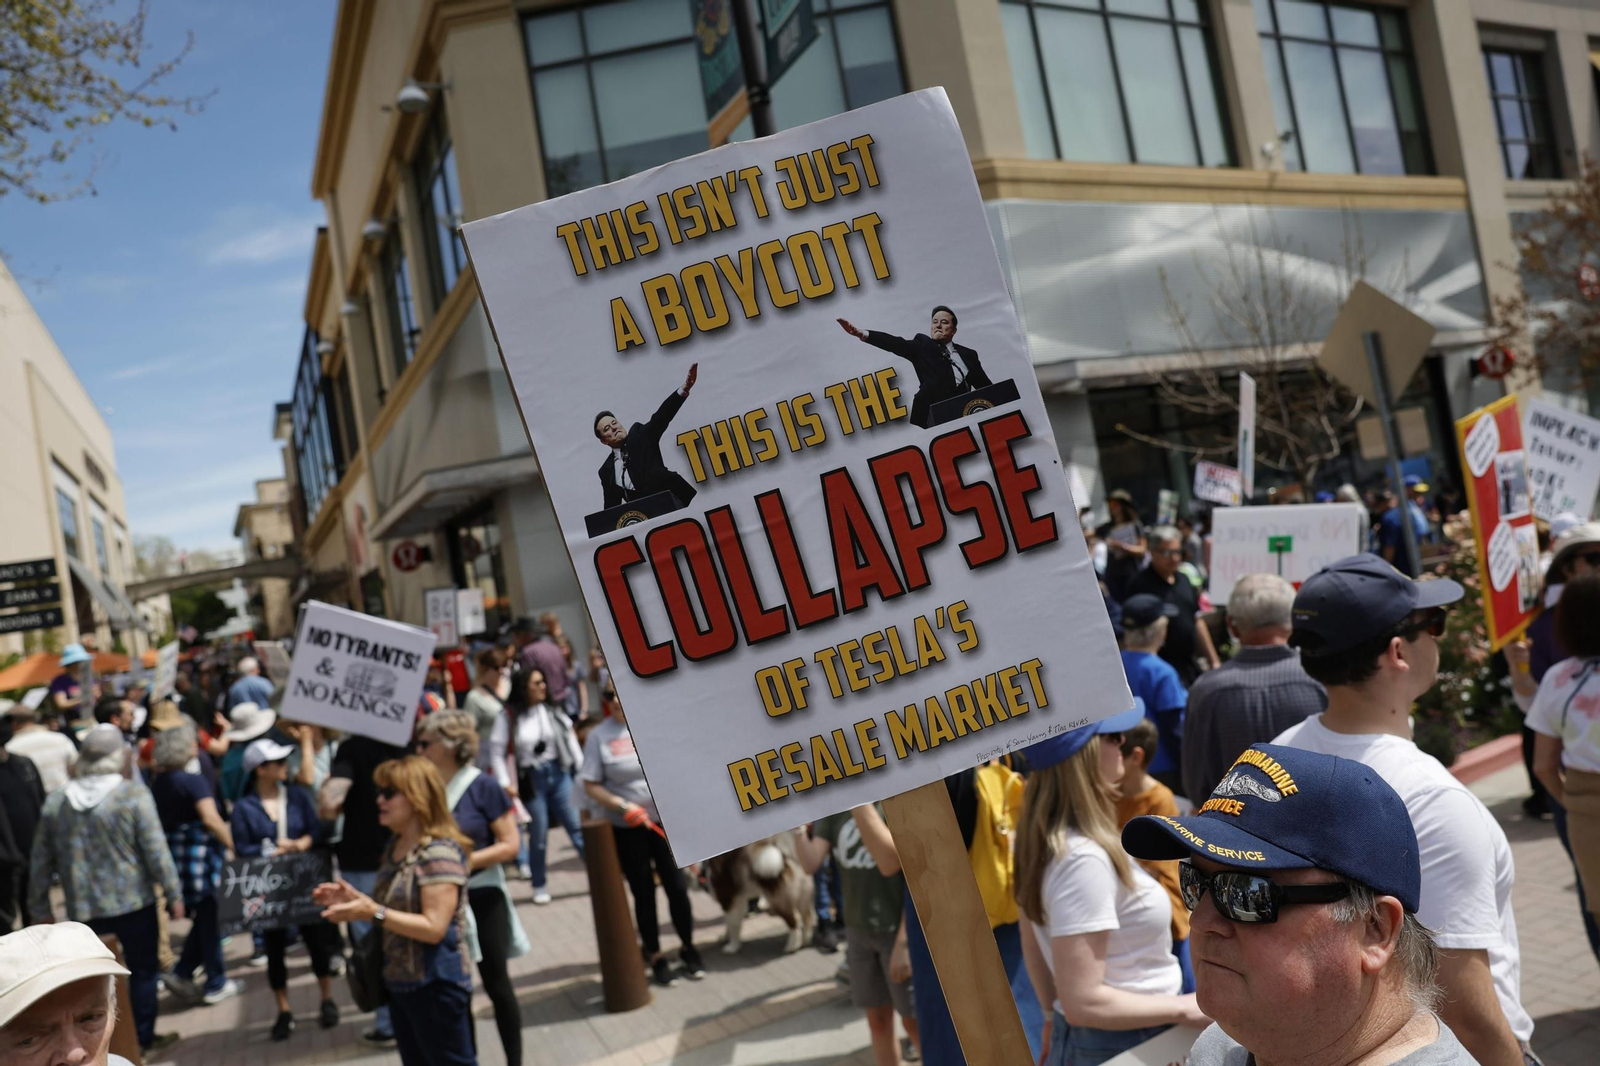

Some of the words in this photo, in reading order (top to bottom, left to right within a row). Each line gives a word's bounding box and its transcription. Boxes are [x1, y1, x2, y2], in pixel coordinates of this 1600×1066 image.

[556, 200, 661, 277] THIS
[656, 166, 769, 246] ISN'T
[774, 133, 880, 211] JUST
[609, 297, 646, 352] A
[640, 211, 891, 347] BOYCOTT
[676, 407, 780, 483] THIS
[775, 392, 827, 453] IS
[824, 366, 908, 436] THE
[593, 409, 1058, 678] COLLAPSE
[305, 626, 332, 647] NO
[335, 632, 421, 672] TYRANTS!
[315, 656, 336, 677] &
[754, 657, 810, 718] OF
[813, 599, 980, 699] TESLA'S
[293, 678, 330, 702] NO
[330, 687, 407, 723] KINGS!
[726, 718, 887, 812] RESALE
[883, 657, 1049, 760] MARKET
[1199, 797, 1246, 817] ERVICE
[1229, 749, 1299, 797] UBMARINE
[1207, 843, 1266, 862] SERVICE
